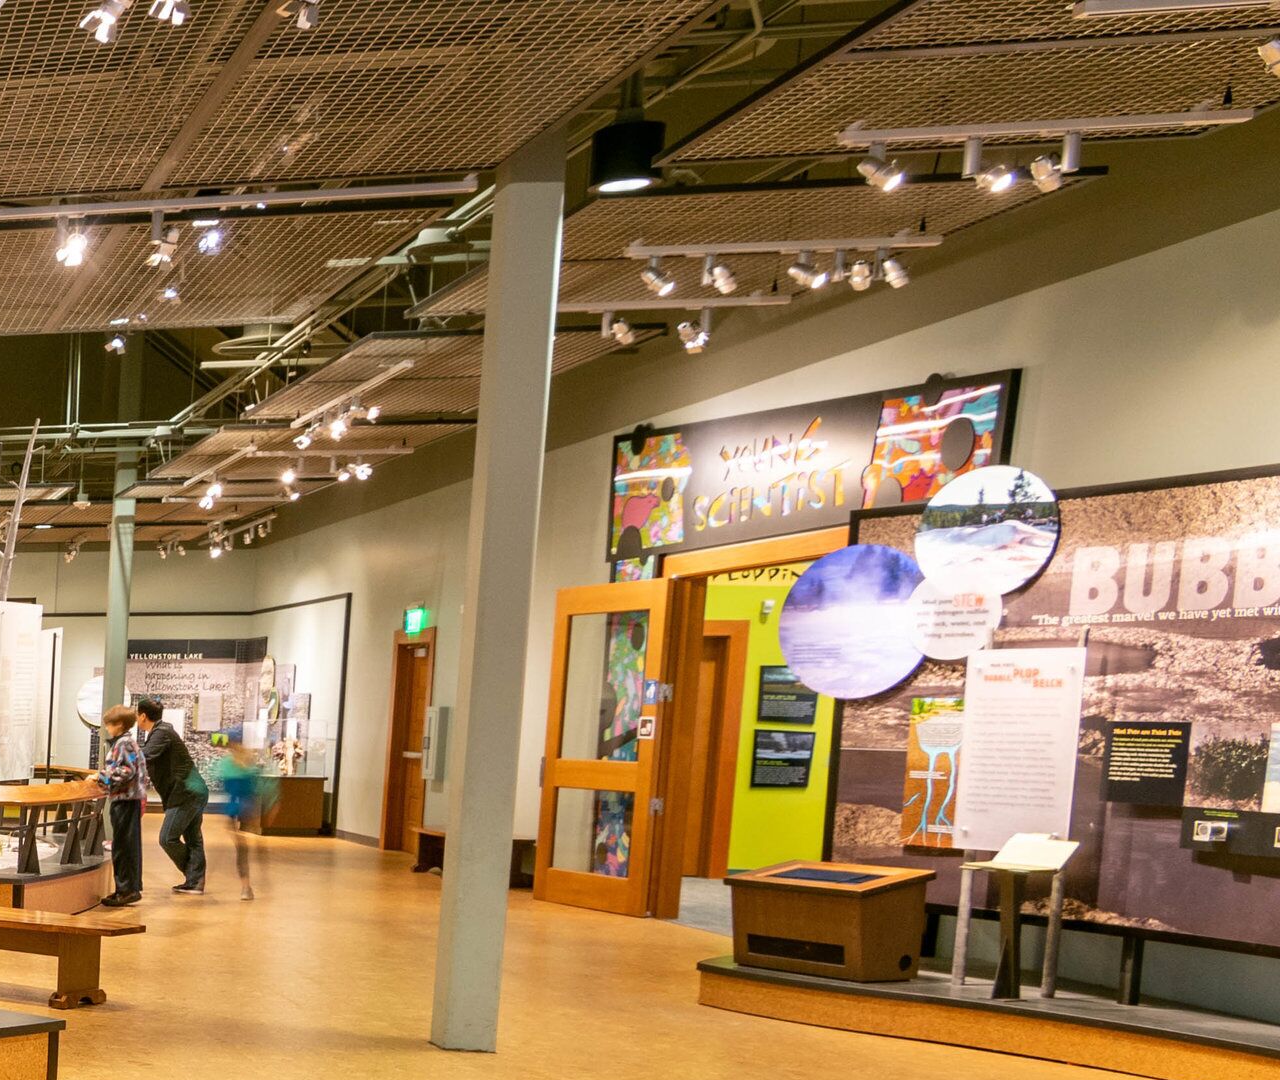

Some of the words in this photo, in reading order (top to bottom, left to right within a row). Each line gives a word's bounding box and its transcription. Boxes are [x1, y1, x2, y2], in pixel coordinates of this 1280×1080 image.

[1069, 529, 1280, 616] BUBB
[1061, 612, 1109, 626] greatest
[1112, 610, 1155, 622] marvel
[1158, 610, 1176, 621] we
[1179, 609, 1209, 620] have
[1212, 607, 1231, 621] yet
[1234, 607, 1259, 618] met
[145, 660, 173, 669] What
[145, 671, 195, 682] happening
[197, 672, 210, 680] in
[145, 681, 200, 691] Yellowstone
[202, 681, 230, 691] Lake?
